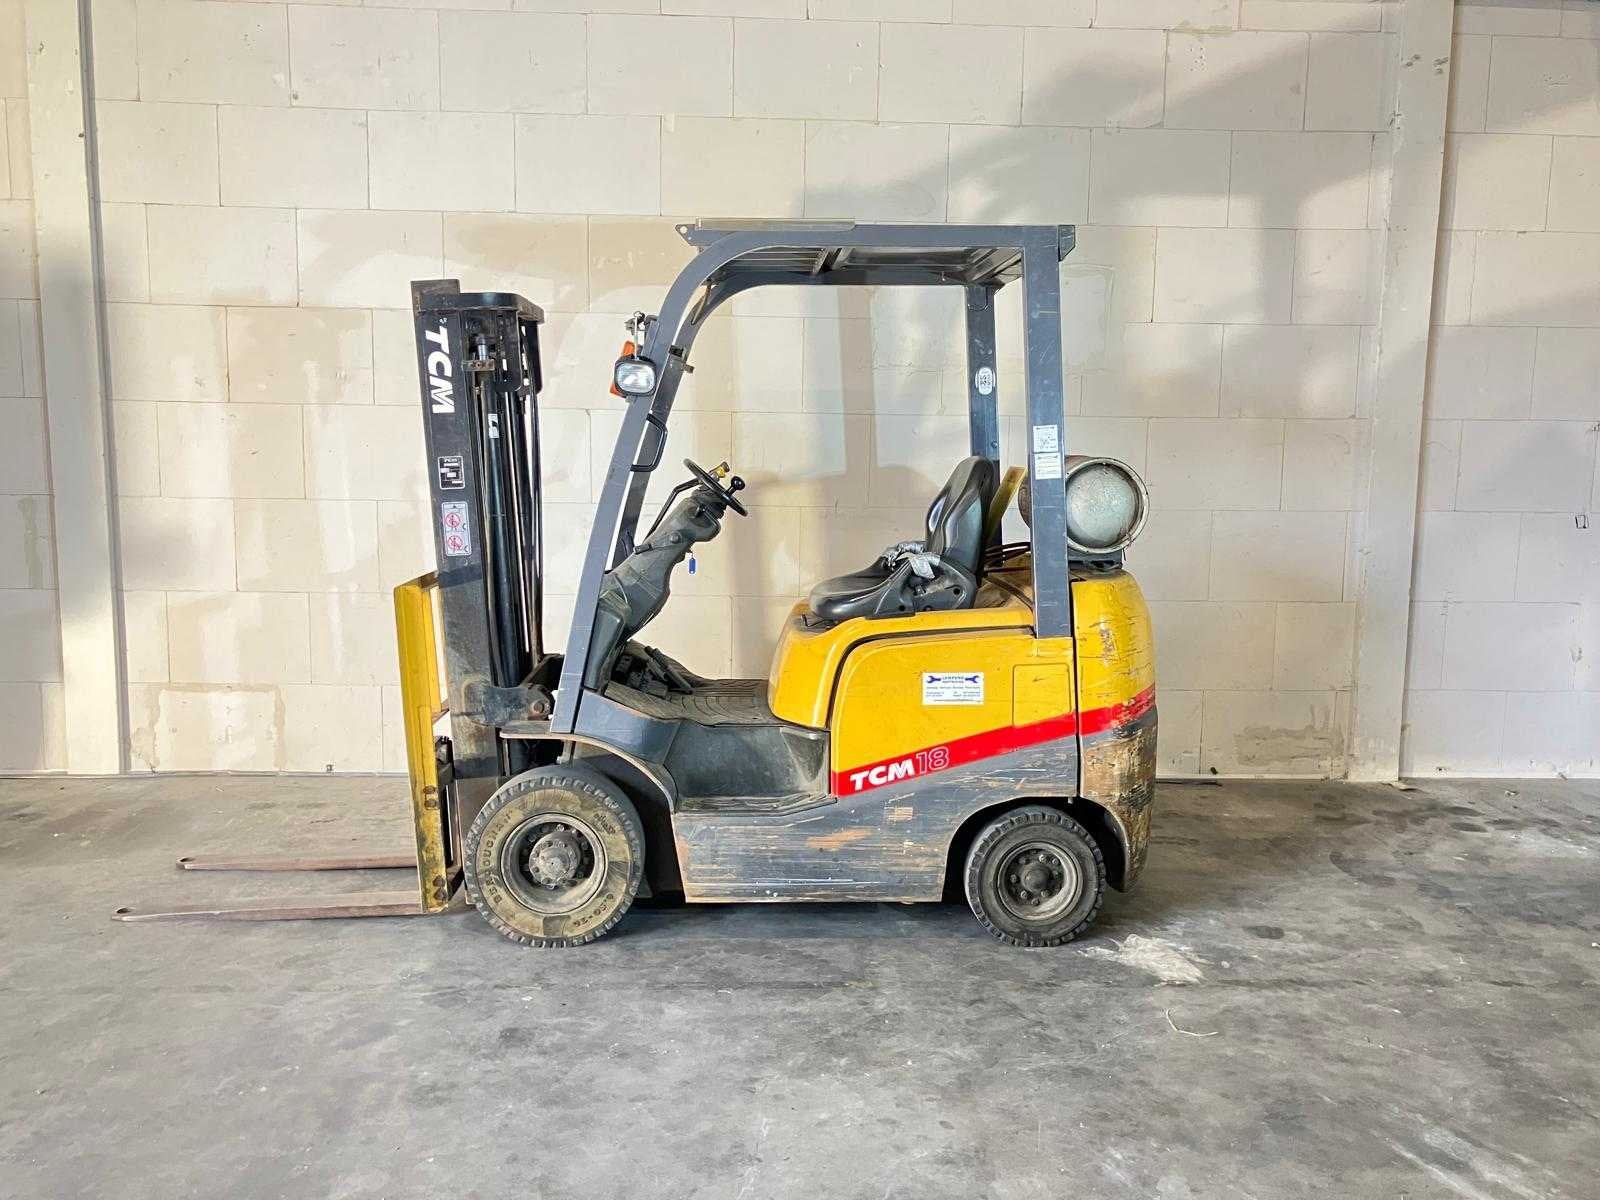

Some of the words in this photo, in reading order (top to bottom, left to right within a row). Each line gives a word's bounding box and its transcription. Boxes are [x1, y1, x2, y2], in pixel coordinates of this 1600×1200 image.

[425, 325, 456, 414] TCM
[850, 759, 915, 791] TCM
[916, 746, 949, 775] 18
